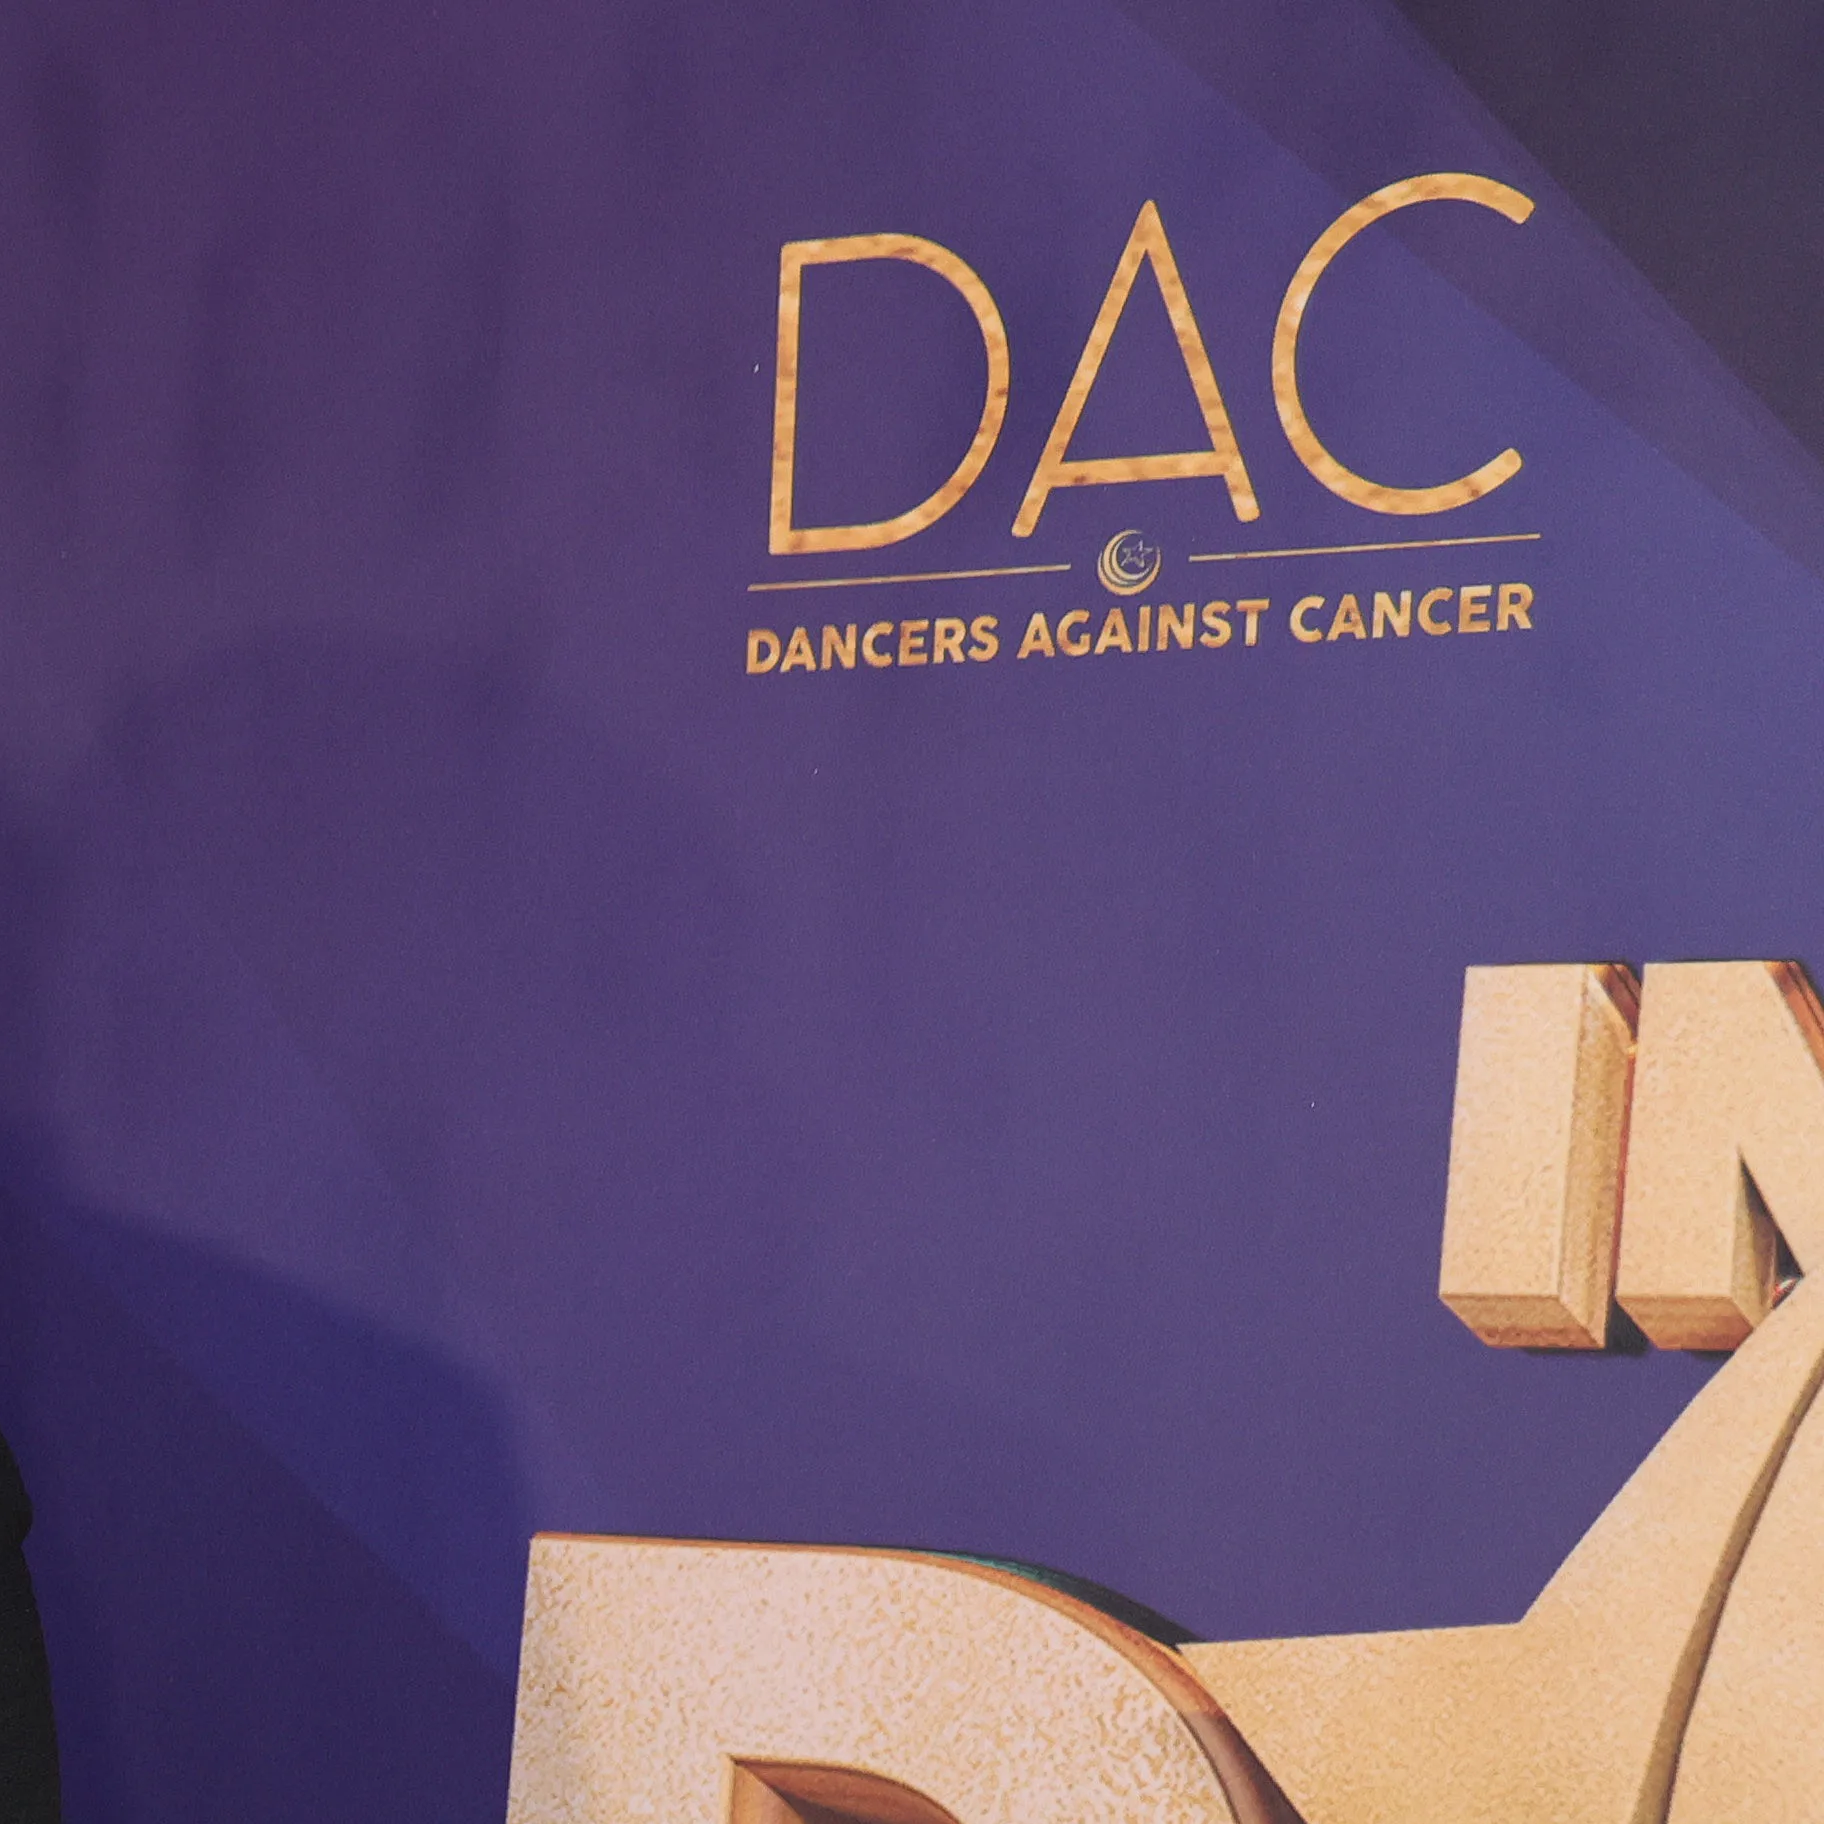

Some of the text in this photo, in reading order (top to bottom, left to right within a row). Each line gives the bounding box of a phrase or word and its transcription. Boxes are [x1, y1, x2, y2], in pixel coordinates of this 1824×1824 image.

[769, 172, 1535, 555] DAC
[746, 582, 1533, 675] DANCERS AGAINST CANCER
